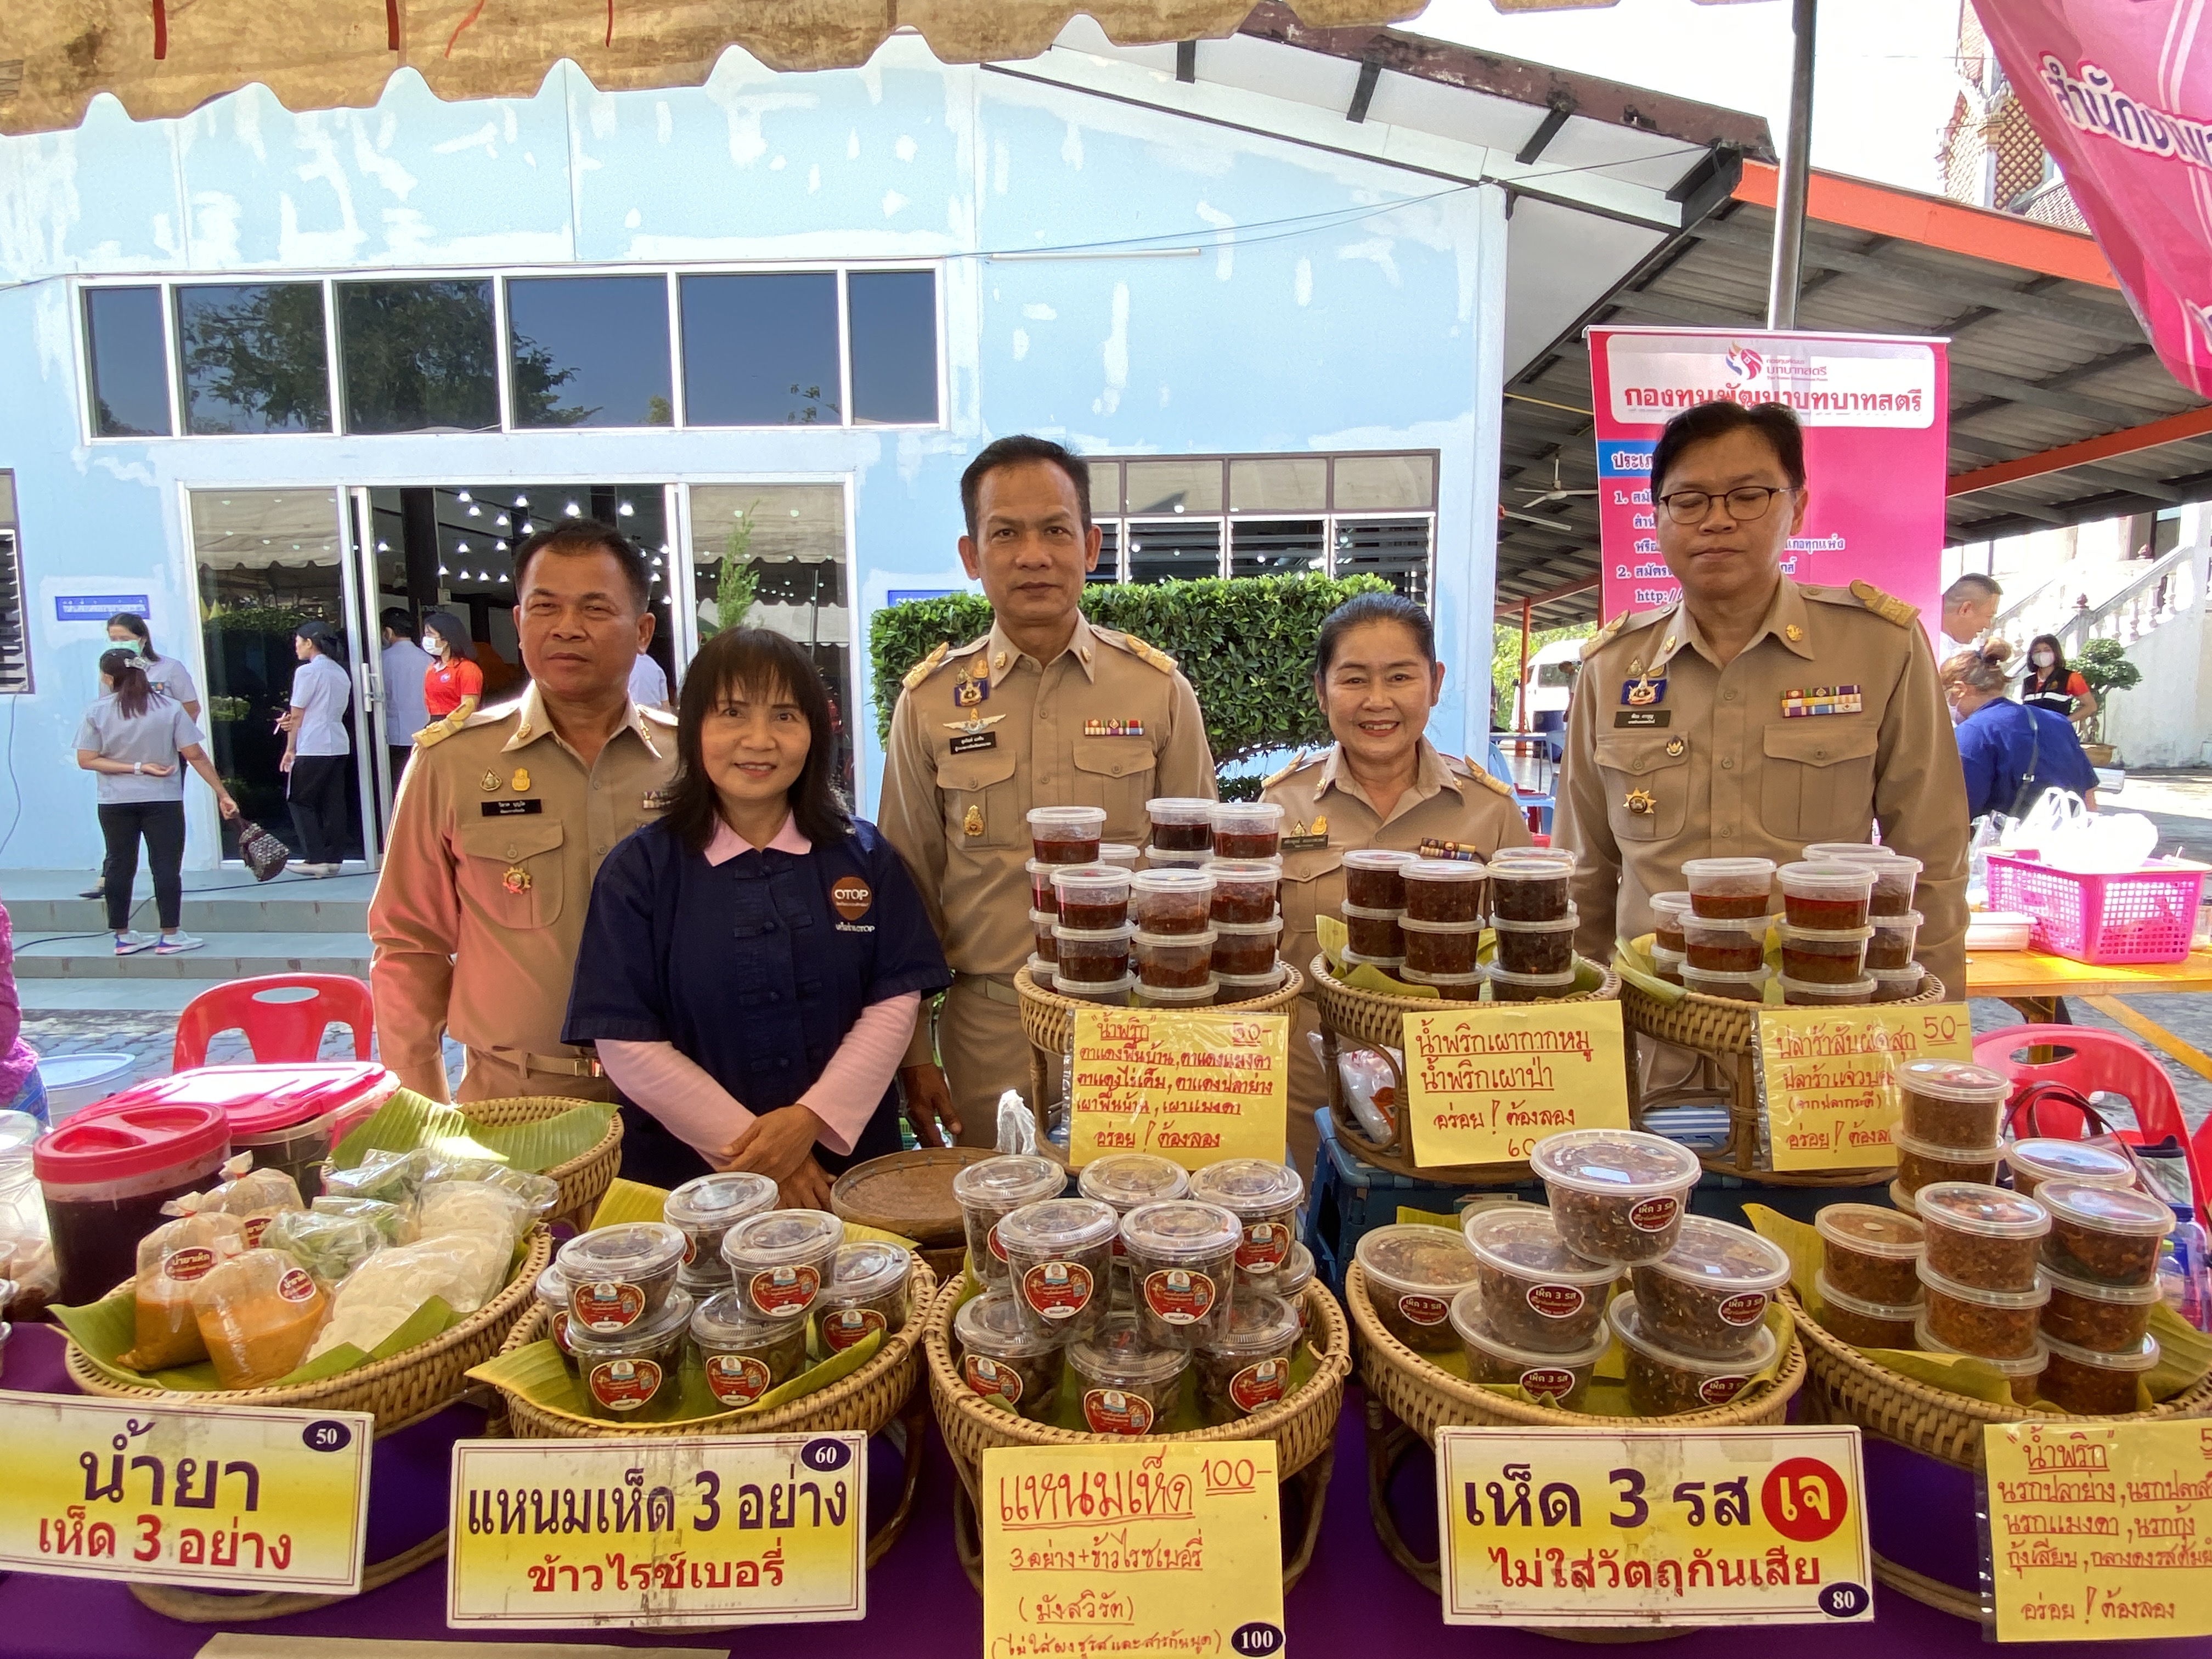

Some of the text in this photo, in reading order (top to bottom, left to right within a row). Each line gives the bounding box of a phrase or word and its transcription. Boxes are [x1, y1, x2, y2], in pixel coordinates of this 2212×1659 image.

[1625, 382, 1921, 411] กองทนพัฒนาบทบาทสตรี
[1615, 490, 1651, 504] 1. สมั
[1617, 567, 1631, 577] 2.
[1636, 563, 1672, 578] สมัคร
[1637, 591, 1683, 603] http://
[834, 889, 868, 900] OTOP
[1416, 1018, 1592, 1061] น้ำพริกเผากากหมู
[1421, 1056, 1553, 1090] น้ำพริกเผาป่า
[1506, 1100, 1575, 1125] ต้องลอง
[315, 1428, 337, 1445] 50
[2200, 1428, 2212, 1453] 5
[80, 1419, 260, 1511] น้ำยา
[815, 1446, 837, 1464] 60
[1000, 1444, 1193, 1521] แหนมเห็ด
[1464, 1463, 1832, 1528] เห็ด 3 รส เจ
[468, 1464, 847, 1534] แหนมเห็ด 3 อย่าง
[39, 1505, 291, 1570] เห็ด 3 อย่าง
[527, 1537, 785, 1593] ข้าวไรซ์เบอรี่
[1488, 1545, 1820, 1597] ไม่ใส่วัตถุกันเสีย
[1832, 1590, 1855, 1609] 80
[2102, 1587, 2175, 1619] ต้องลอง
[1241, 1632, 1273, 1649] 100
